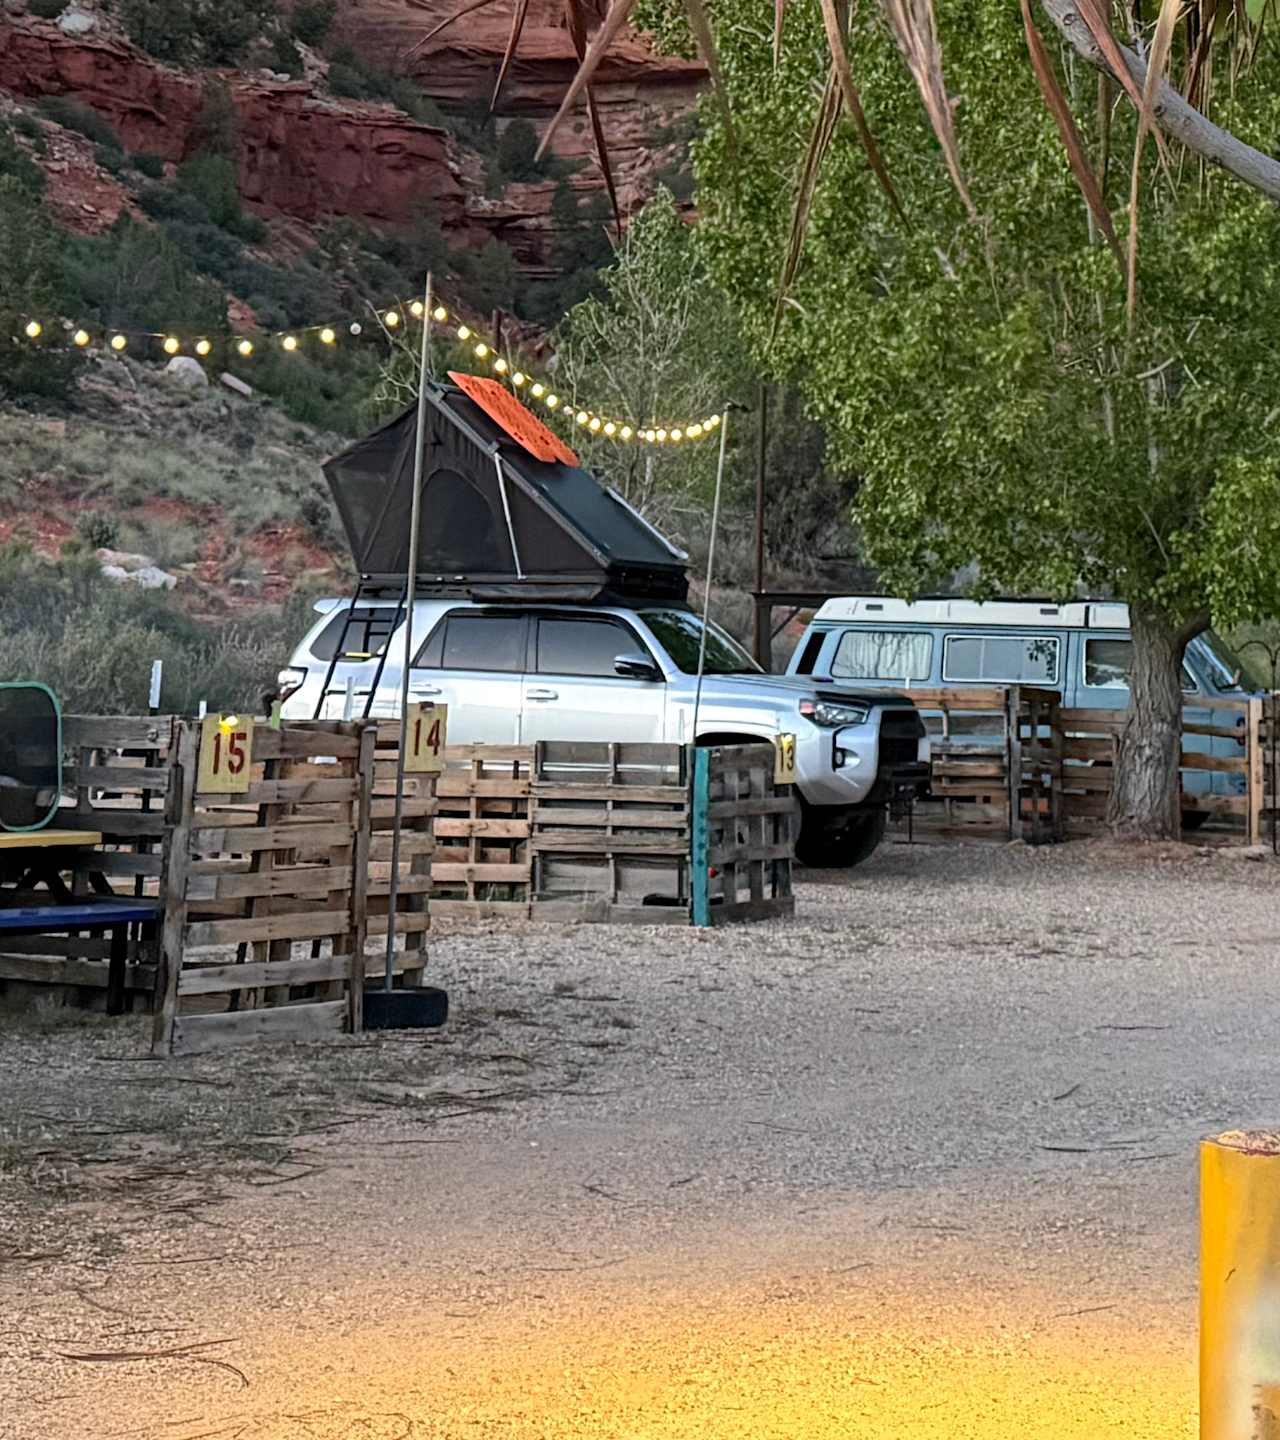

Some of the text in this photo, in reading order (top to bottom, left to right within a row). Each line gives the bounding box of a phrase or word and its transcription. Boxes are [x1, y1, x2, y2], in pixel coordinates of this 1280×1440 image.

[211, 731, 248, 776] 15
[413, 716, 441, 757] 14
[780, 744, 795, 773] 13
